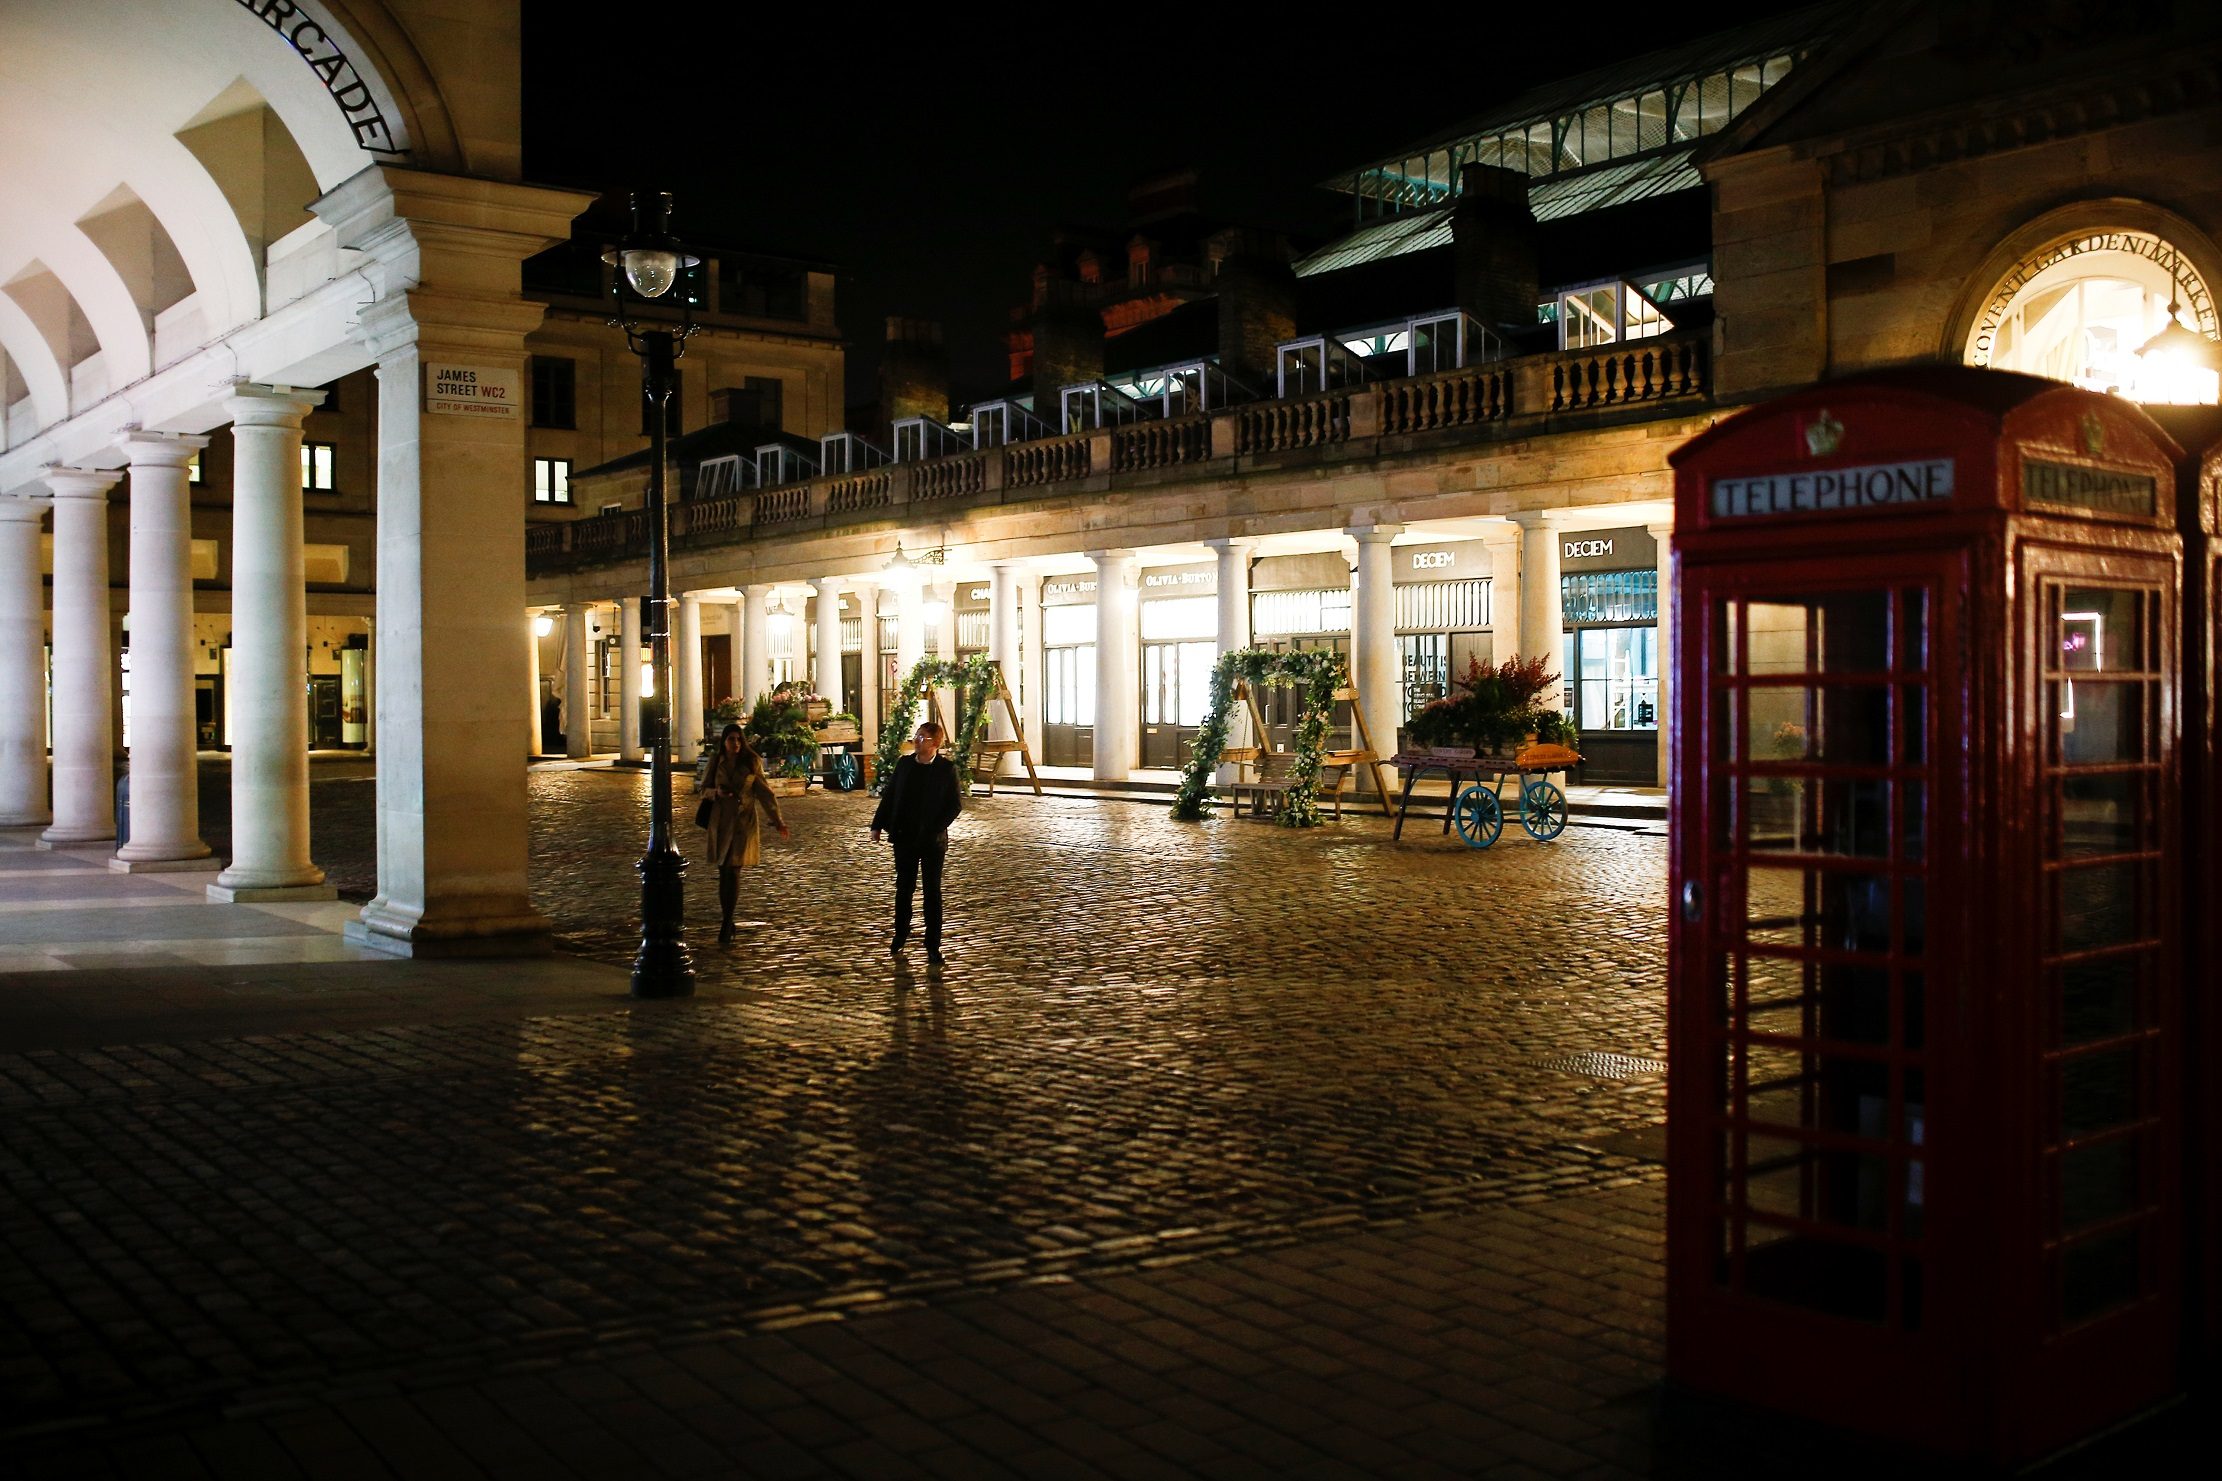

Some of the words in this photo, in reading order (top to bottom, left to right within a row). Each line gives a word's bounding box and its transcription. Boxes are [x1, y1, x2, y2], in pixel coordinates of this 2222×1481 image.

[2035, 233, 2140, 271] GARDEN
[437, 369, 476, 383] JAMES
[437, 383, 478, 396] STREET
[481, 386, 505, 398] WC2
[437, 402, 451, 410] CITY
[453, 403, 462, 411] OF
[464, 405, 510, 414] WESTMINSTER
[1719, 462, 1947, 515] TELEPHONE
[2024, 462, 2149, 510] TELEPHONE
[1564, 539, 1613, 559] DECIEM
[1412, 551, 1455, 569] DECIEM
[1047, 583, 1076, 594] OLIVIA
[1146, 574, 1178, 588] OLIVIA
[1404, 671, 1446, 682] BETWEN
